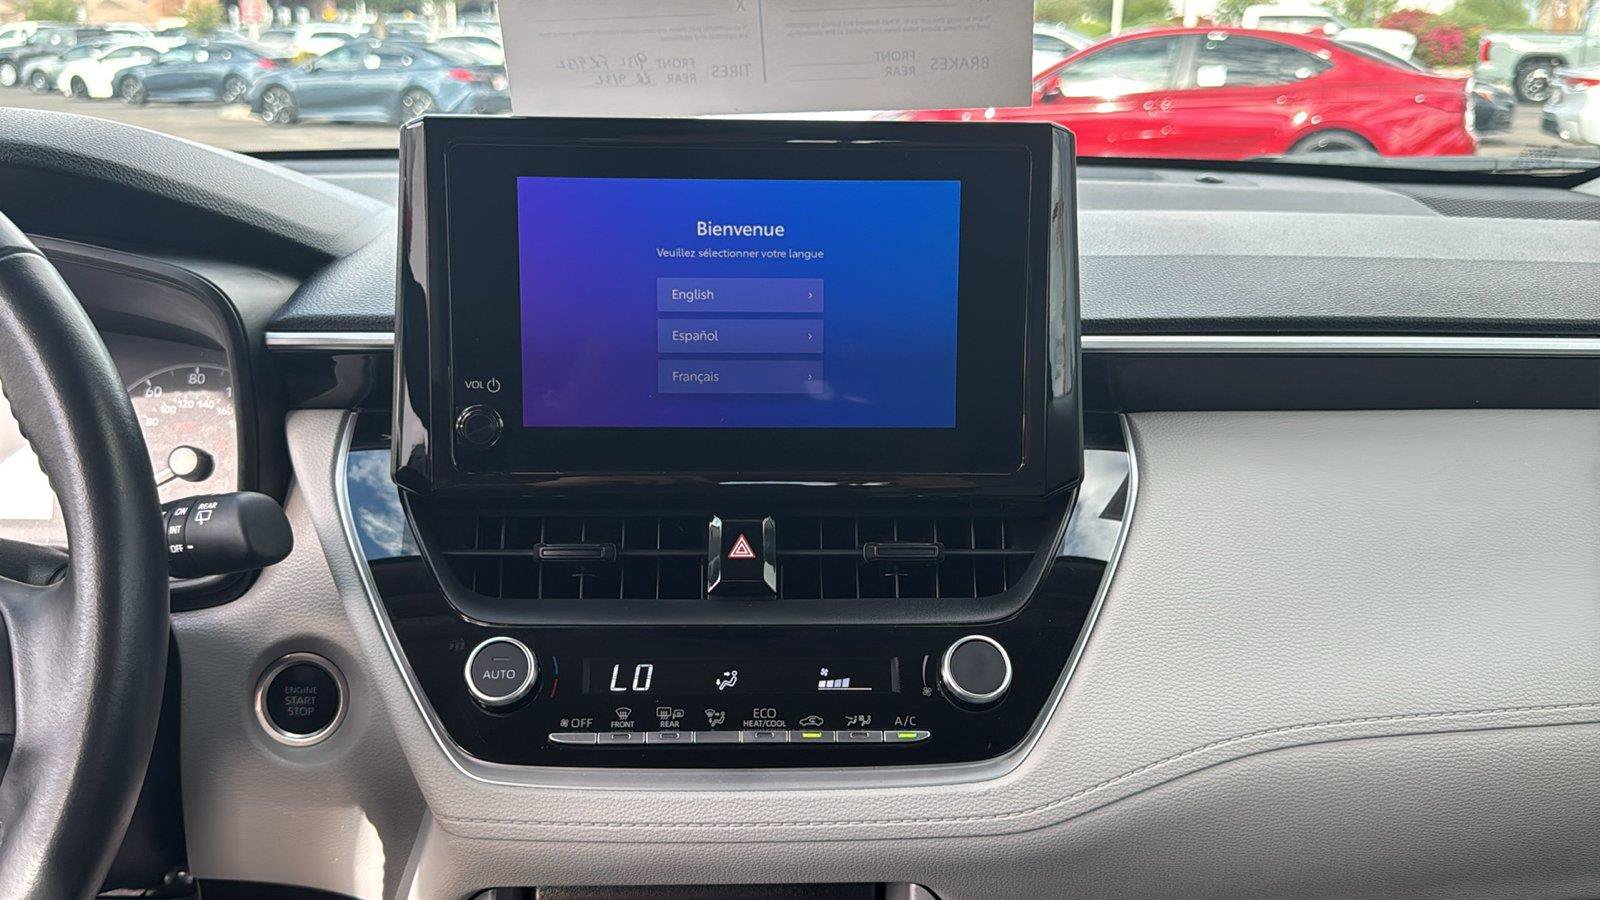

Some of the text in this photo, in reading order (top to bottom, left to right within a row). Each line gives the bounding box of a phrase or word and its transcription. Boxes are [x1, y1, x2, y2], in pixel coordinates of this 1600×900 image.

[696, 220, 785, 237] Bienvenue
[656, 247, 824, 261] Veuillez sélectionner votre langue
[671, 289, 715, 303] English
[672, 330, 719, 343] Español
[187, 373, 206, 385] 80
[672, 371, 720, 384] Français
[464, 380, 485, 389] VOL
[145, 386, 163, 398] 60
[161, 403, 178, 415] 100
[177, 399, 196, 409] 120
[197, 399, 215, 409] 140
[197, 501, 218, 510] REAR
[174, 507, 189, 516] ON
[169, 525, 182, 535] INT
[169, 544, 184, 553] OFF
[482, 669, 516, 680] AUTO
[284, 686, 318, 695] ENGINE
[284, 695, 317, 706] START
[287, 706, 315, 717] STOP
[753, 707, 777, 719] ECO
[570, 717, 594, 729] OFF
[610, 719, 635, 728] FRONT
[659, 719, 681, 728] REAR
[742, 719, 787, 728] HEAT/COOL
[894, 715, 917, 727] A/C
